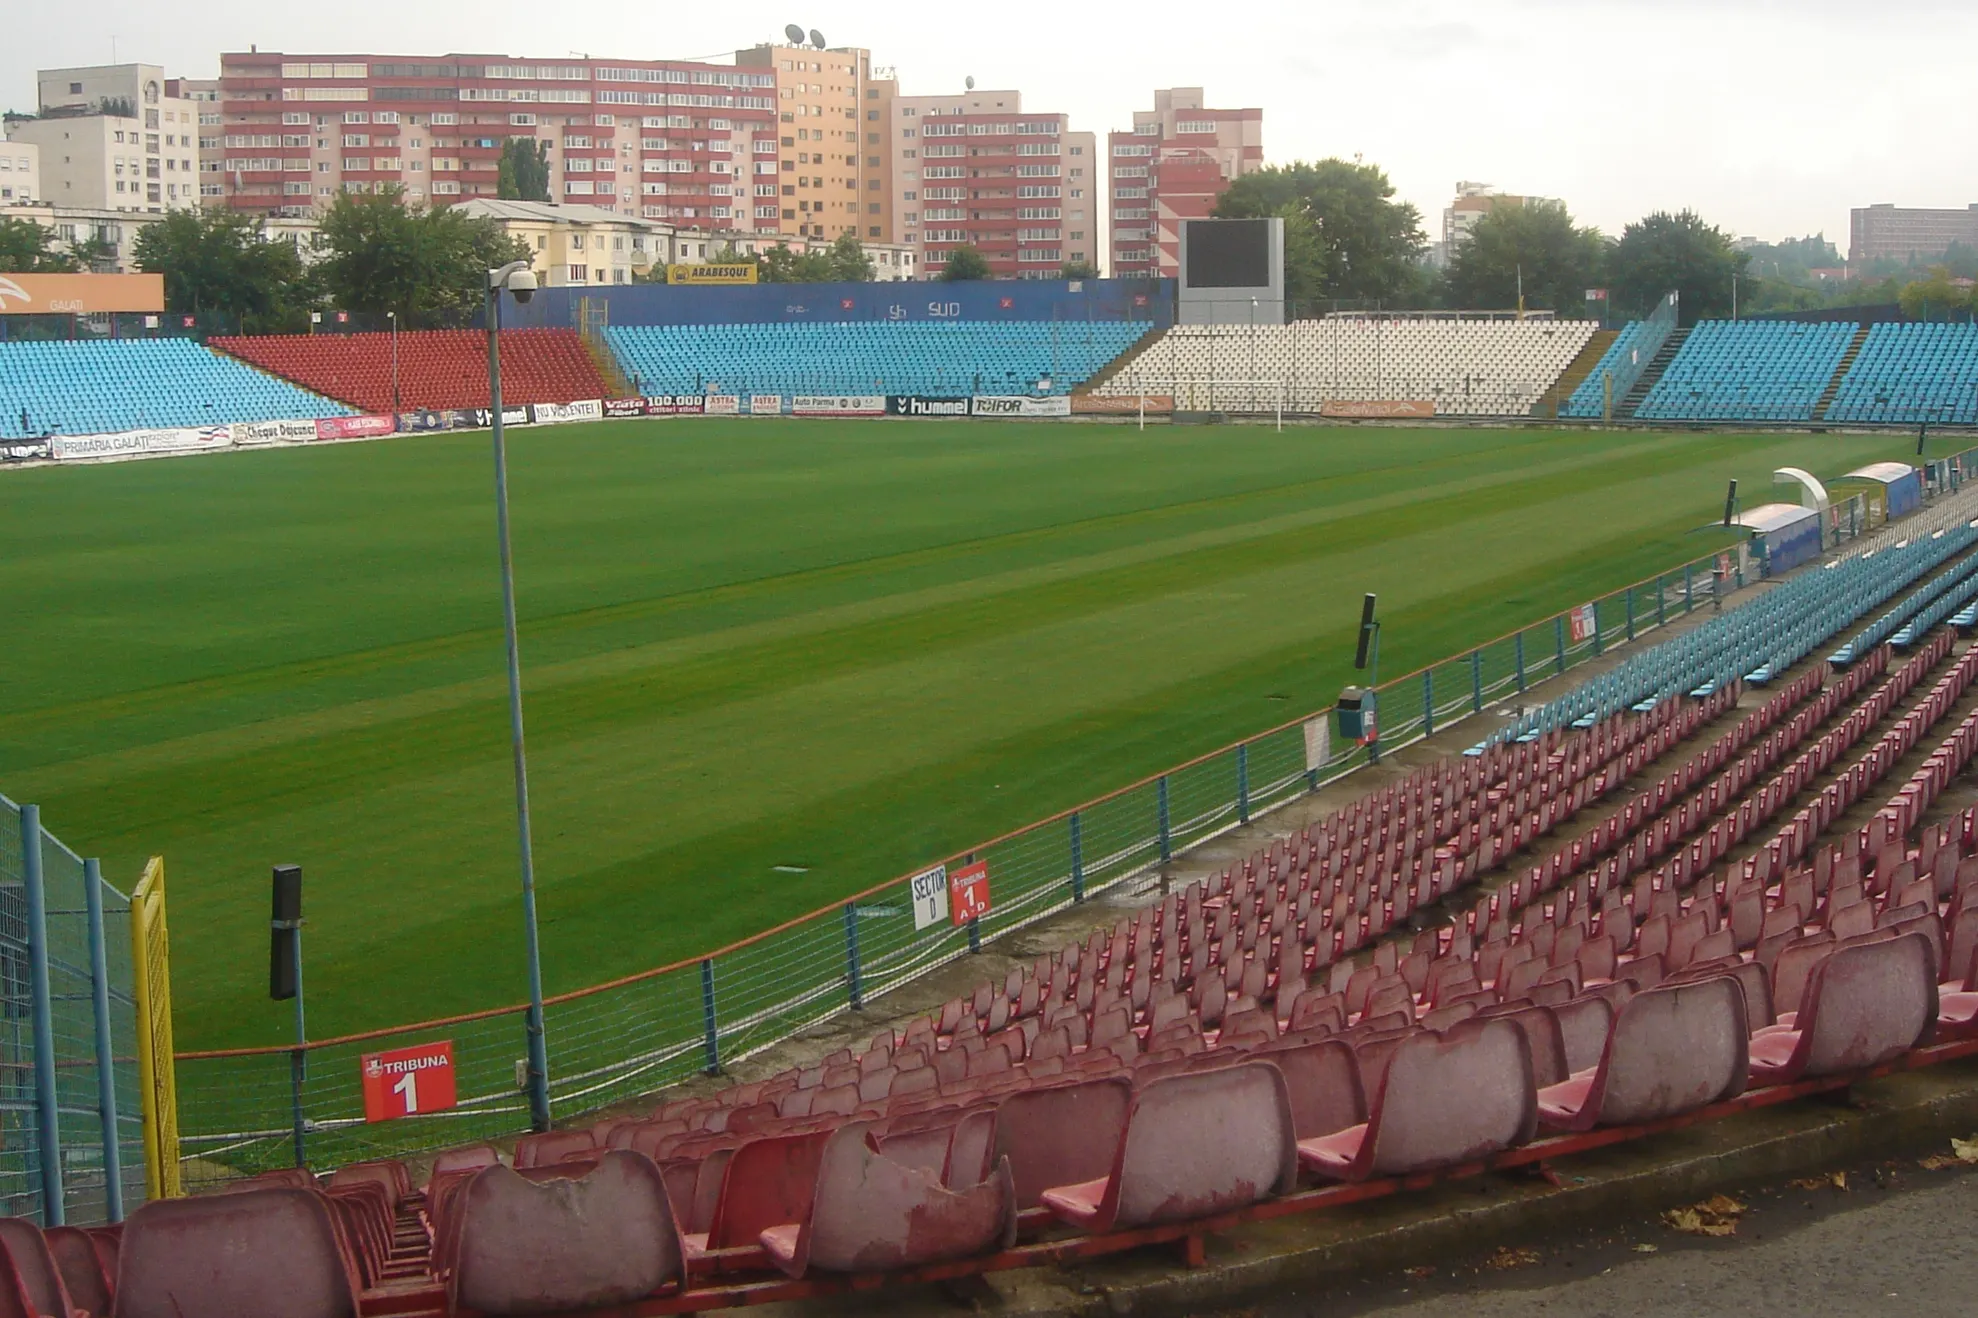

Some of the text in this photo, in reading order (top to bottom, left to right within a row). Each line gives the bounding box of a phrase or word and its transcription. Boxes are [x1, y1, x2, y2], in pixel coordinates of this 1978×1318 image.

[692, 267, 748, 277] ARABESQUE
[928, 302, 960, 317] SUD
[648, 396, 703, 406] 100.000
[710, 396, 734, 404] ASTRA
[754, 396, 777, 404] ASTRA
[795, 398, 810, 406] Auto
[812, 398, 835, 406] Parma
[911, 398, 967, 414] hummel
[484, 406, 527, 426] hmmel
[536, 404, 549, 418] NU
[914, 868, 946, 901] SECTOR
[964, 885, 974, 907] 1
[960, 909, 968, 920] A
[977, 901, 985, 912] D
[384, 1054, 448, 1074] TRIBUNA
[394, 1072, 417, 1113] 1
